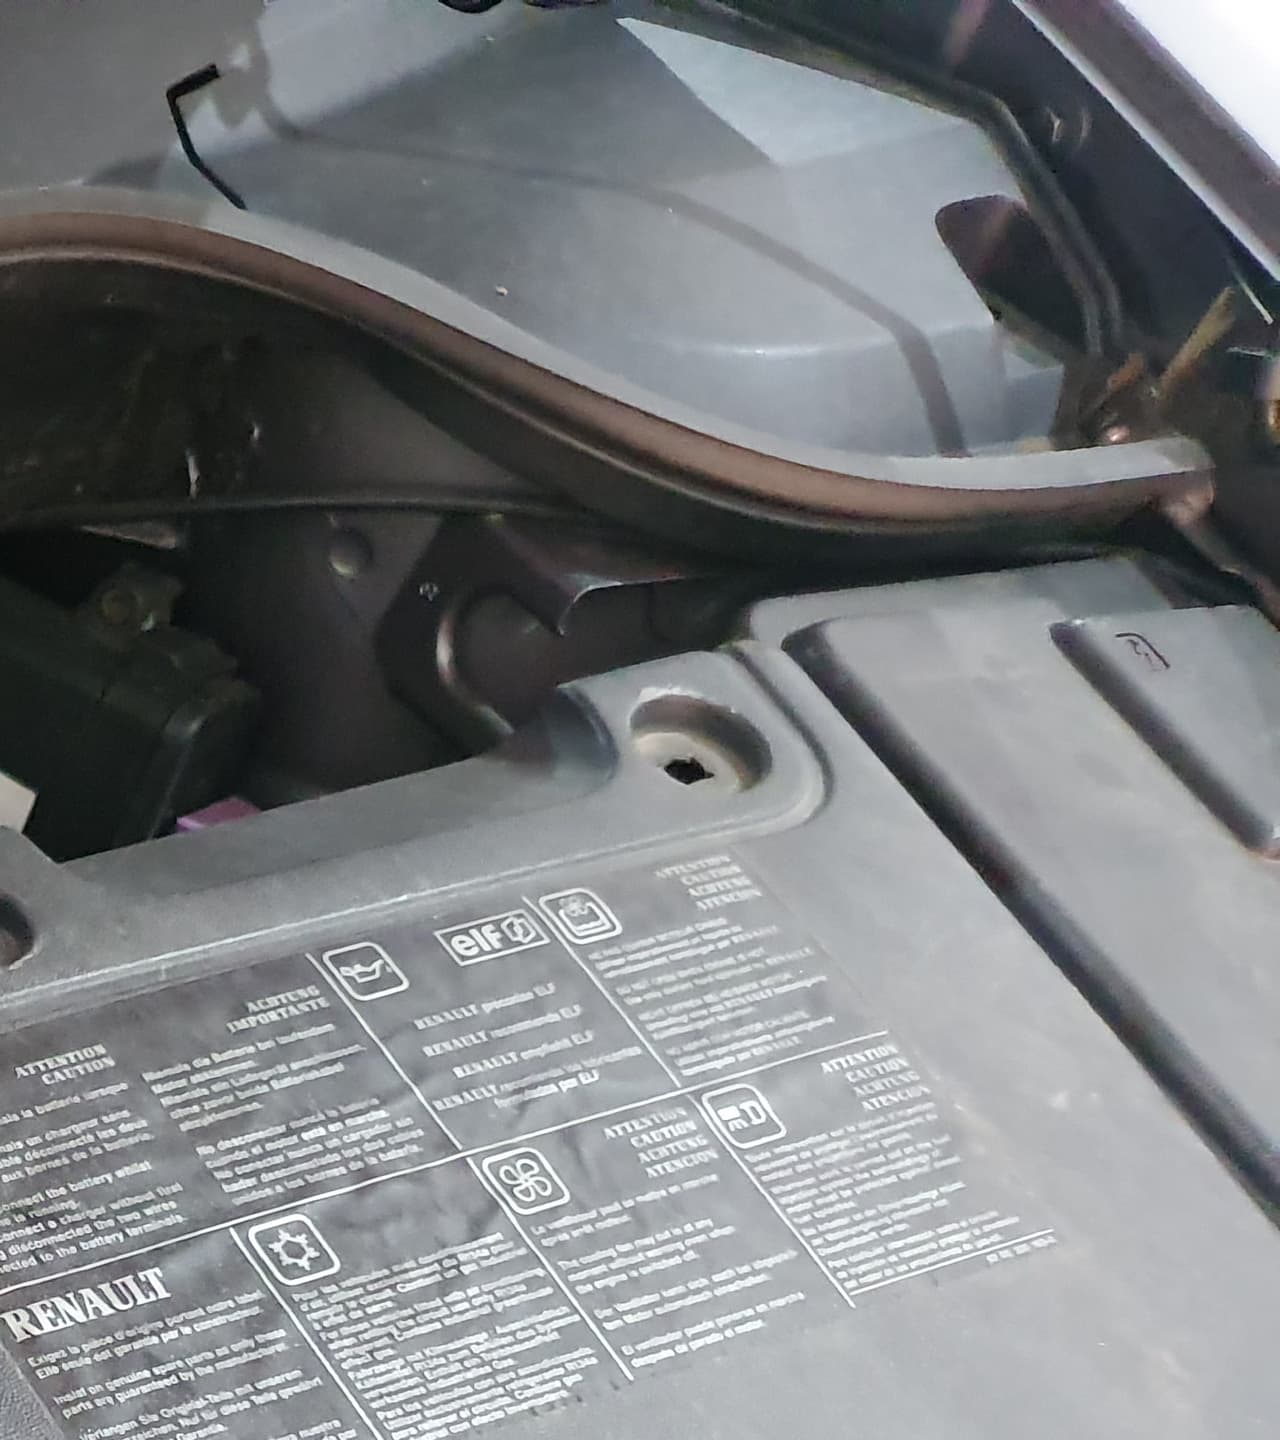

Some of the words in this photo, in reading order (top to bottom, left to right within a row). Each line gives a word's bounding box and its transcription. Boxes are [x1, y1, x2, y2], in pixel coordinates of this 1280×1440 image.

[450, 923, 501, 956] elf
[246, 984, 320, 1012] ACHTUNG
[413, 1003, 478, 1030] RENAULT
[532, 981, 556, 997] ELF
[226, 996, 329, 1032] IMPORTANTE
[421, 1029, 488, 1057] RENAULT
[558, 1003, 582, 1019] ELF
[14, 1043, 106, 1078] ATTENTION
[452, 1050, 518, 1078] RENAULT
[570, 1029, 594, 1045] ELF
[820, 1044, 898, 1073] ATTENTION
[40, 1056, 115, 1085] CAUTION
[844, 1057, 909, 1083] CAUTION
[432, 1083, 498, 1111] RENAULT
[603, 1106, 687, 1139] ATTENTION
[629, 1119, 697, 1147] CAUTION
[637, 1134, 708, 1163] ACHTUNG
[44, 1185, 67, 1199] the
[66, 1172, 113, 1192] battery
[58, 1204, 106, 1225] charger
[7, 1223, 92, 1255] disconnected
[38, 1252, 54, 1262] to
[54, 1245, 77, 1258] the
[78, 1231, 124, 1250] battery
[1, 1267, 170, 1341] RENAULT
